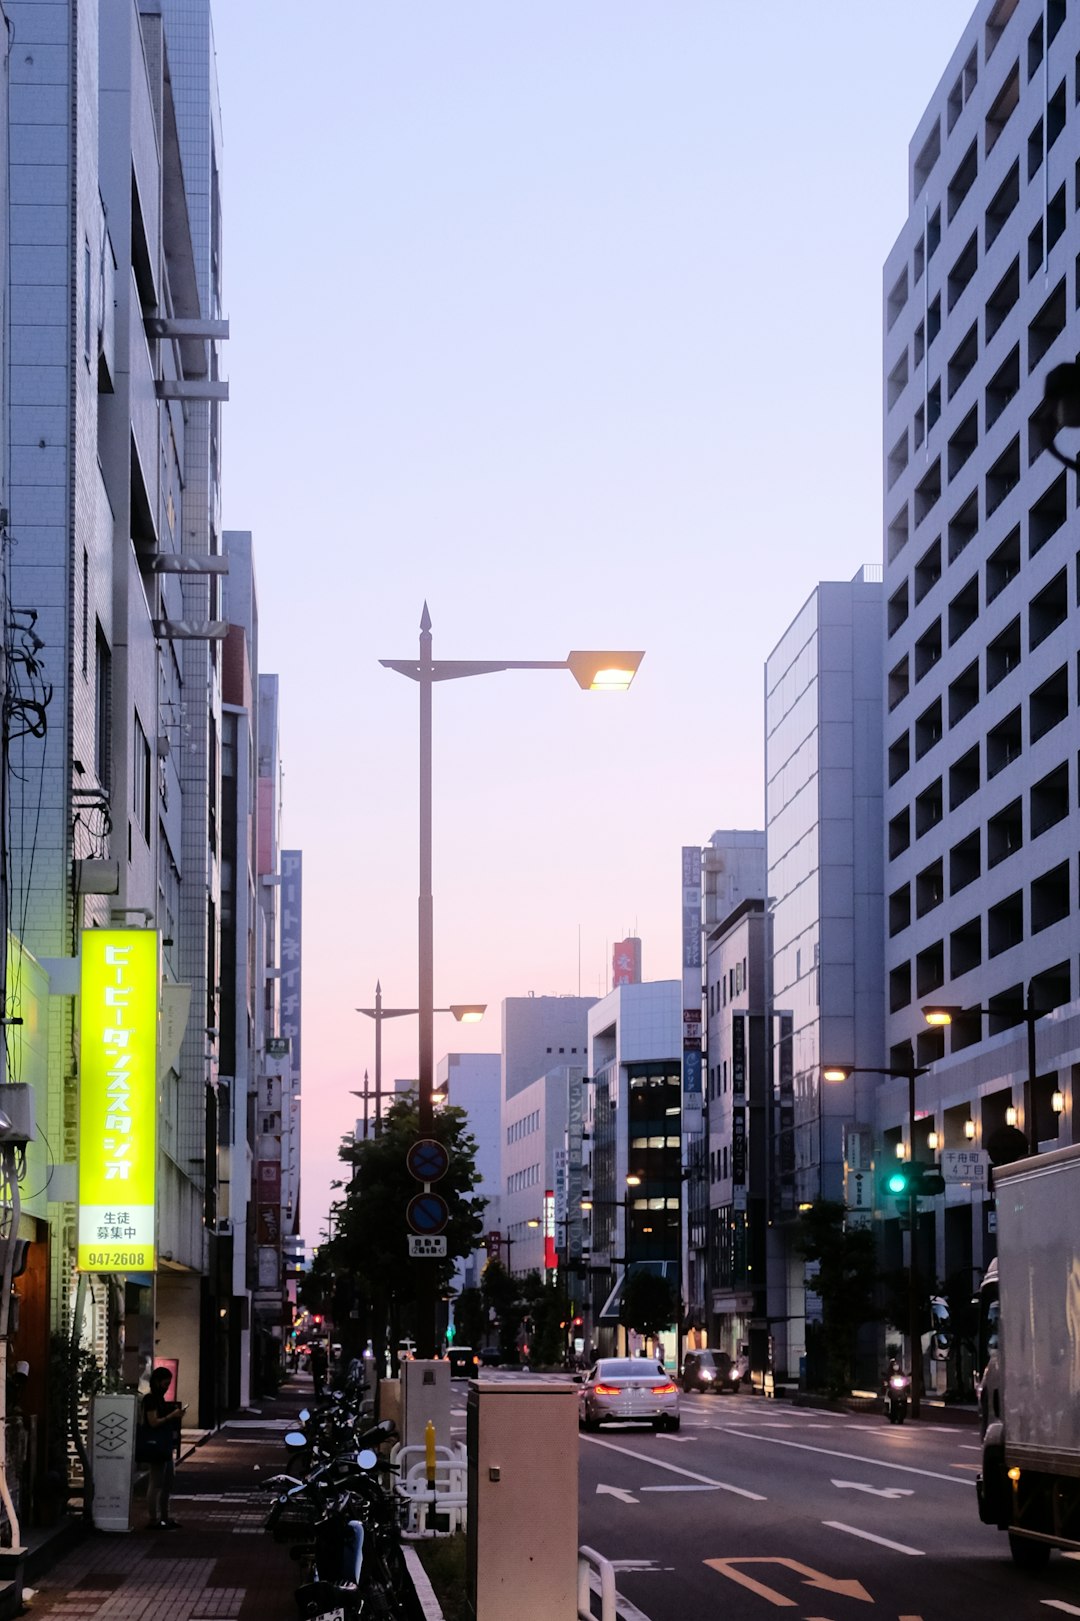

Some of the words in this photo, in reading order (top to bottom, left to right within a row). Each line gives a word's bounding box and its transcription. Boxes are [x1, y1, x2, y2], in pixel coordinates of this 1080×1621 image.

[282, 856, 300, 1064] アートネイチャ
[103, 945, 134, 1180] ビービーダンススタジオ
[946, 1152, 979, 1163] 千舟町
[952, 1165, 984, 1175] 4丁目
[103, 1211, 130, 1225] 生徒
[96, 1226, 137, 1240] 募集中
[88, 1252, 145, 1266] 947-2608
